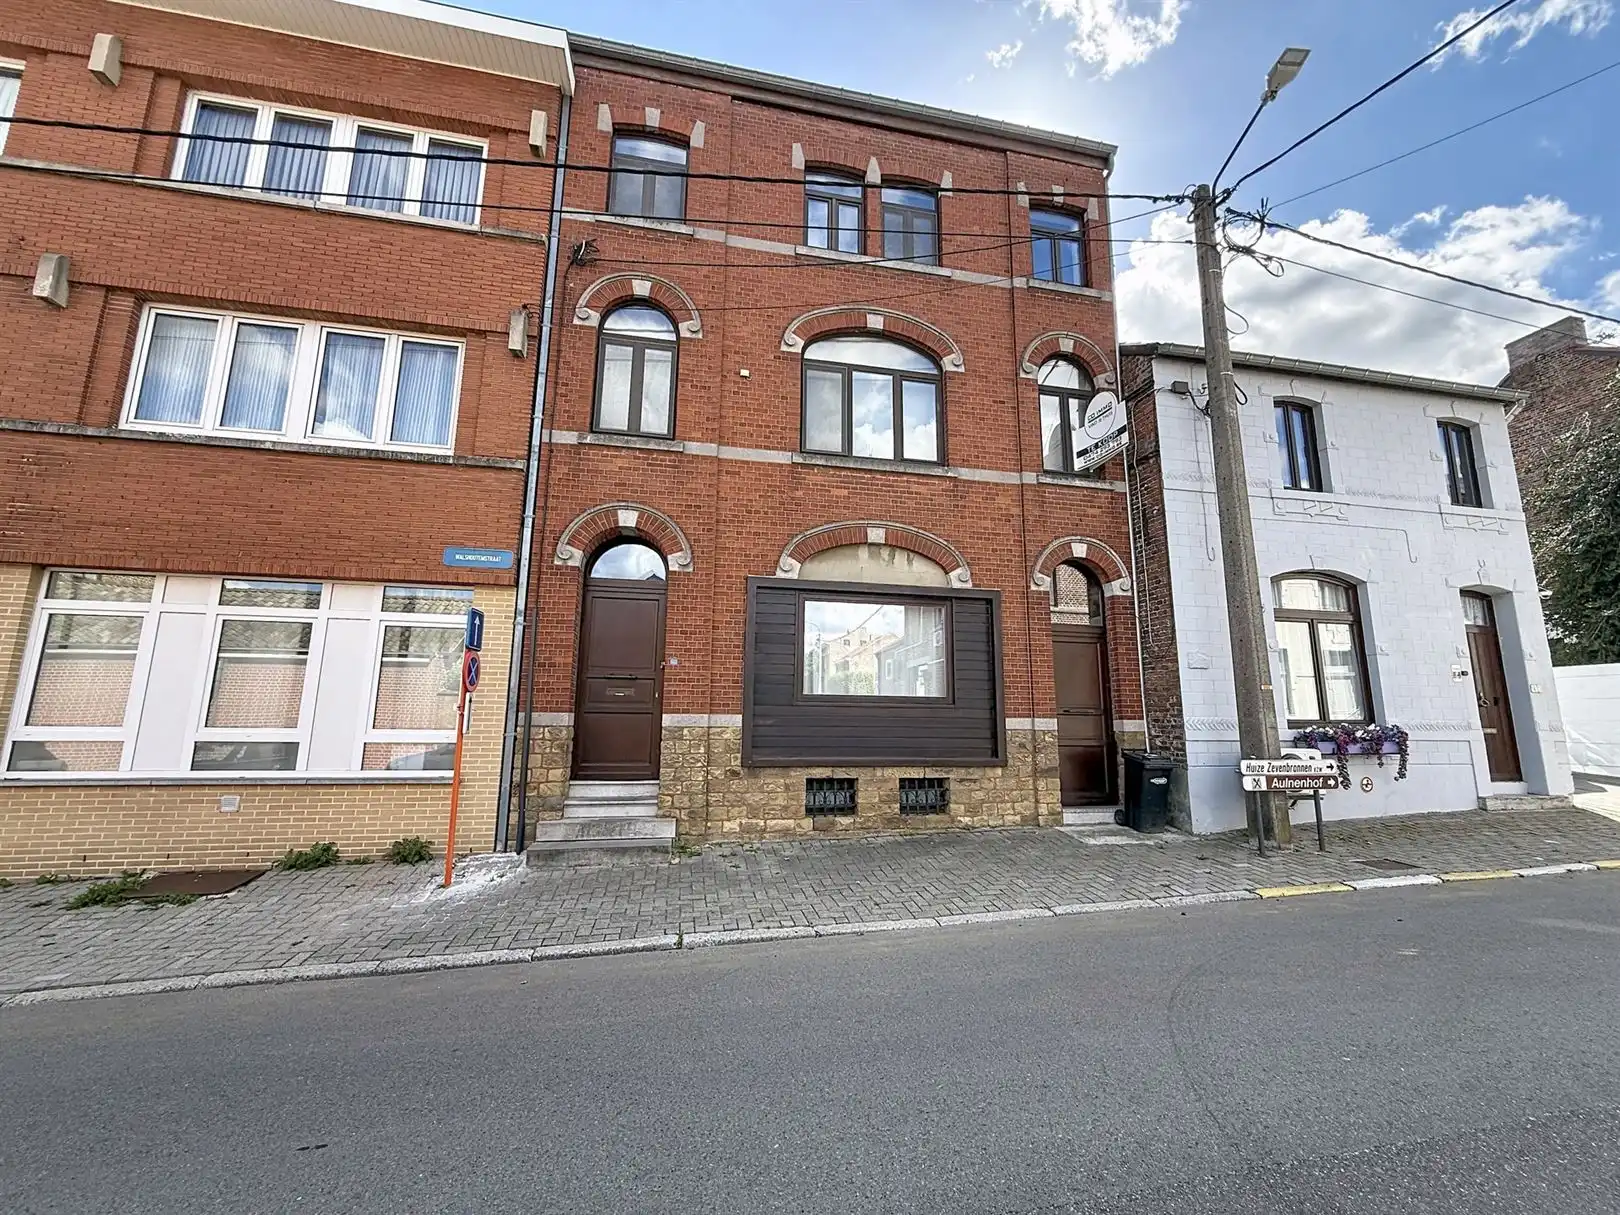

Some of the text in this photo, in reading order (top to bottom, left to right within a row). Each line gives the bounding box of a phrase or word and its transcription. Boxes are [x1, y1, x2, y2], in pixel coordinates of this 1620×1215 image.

[1096, 401, 1113, 415] IMMO
[1087, 430, 1118, 453] TE KOOP
[1246, 762, 1265, 773] Huize
[1267, 762, 1312, 773] Zevenbronnen
[1271, 777, 1324, 788] Aulnenhof
